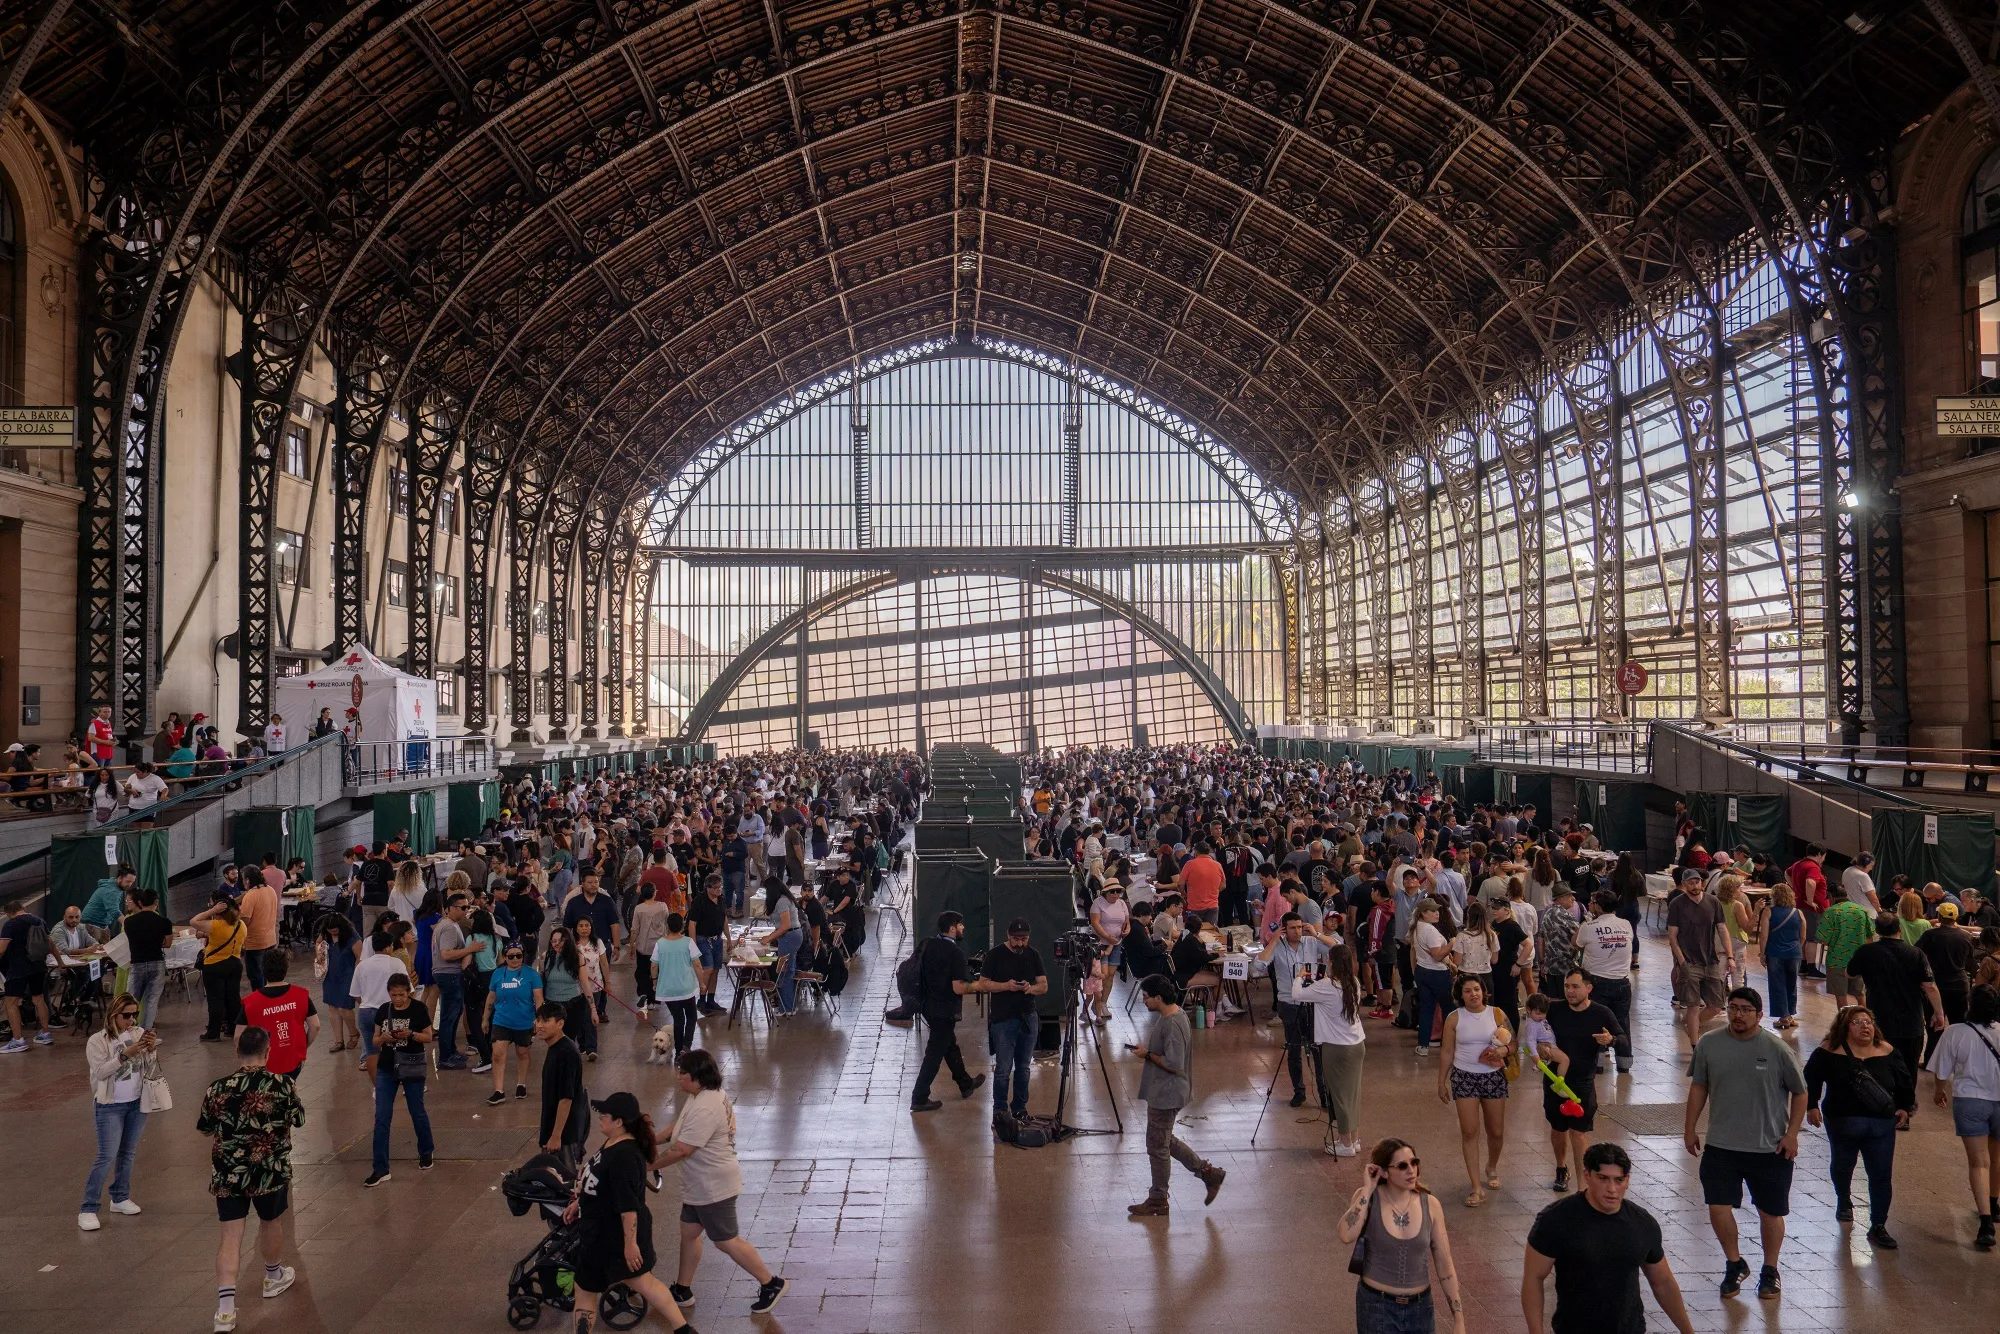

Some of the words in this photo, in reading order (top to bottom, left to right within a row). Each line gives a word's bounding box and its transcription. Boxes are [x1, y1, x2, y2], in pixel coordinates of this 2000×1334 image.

[1970, 400, 1998, 409] SALA
[0, 411, 8, 420] E
[12, 411, 27, 420] LA
[31, 411, 69, 420] BARRA
[1943, 412, 1972, 421] SALA
[0, 423, 12, 433] O
[16, 423, 54, 433] ROJAS
[1949, 425, 1978, 434] SALA
[1595, 926, 1613, 936] H.D.
[1228, 968, 1243, 977] 940
[263, 1002, 297, 1016] AYUDANTE
[276, 1022, 289, 1032] SER
[277, 1030, 290, 1040] VEL
